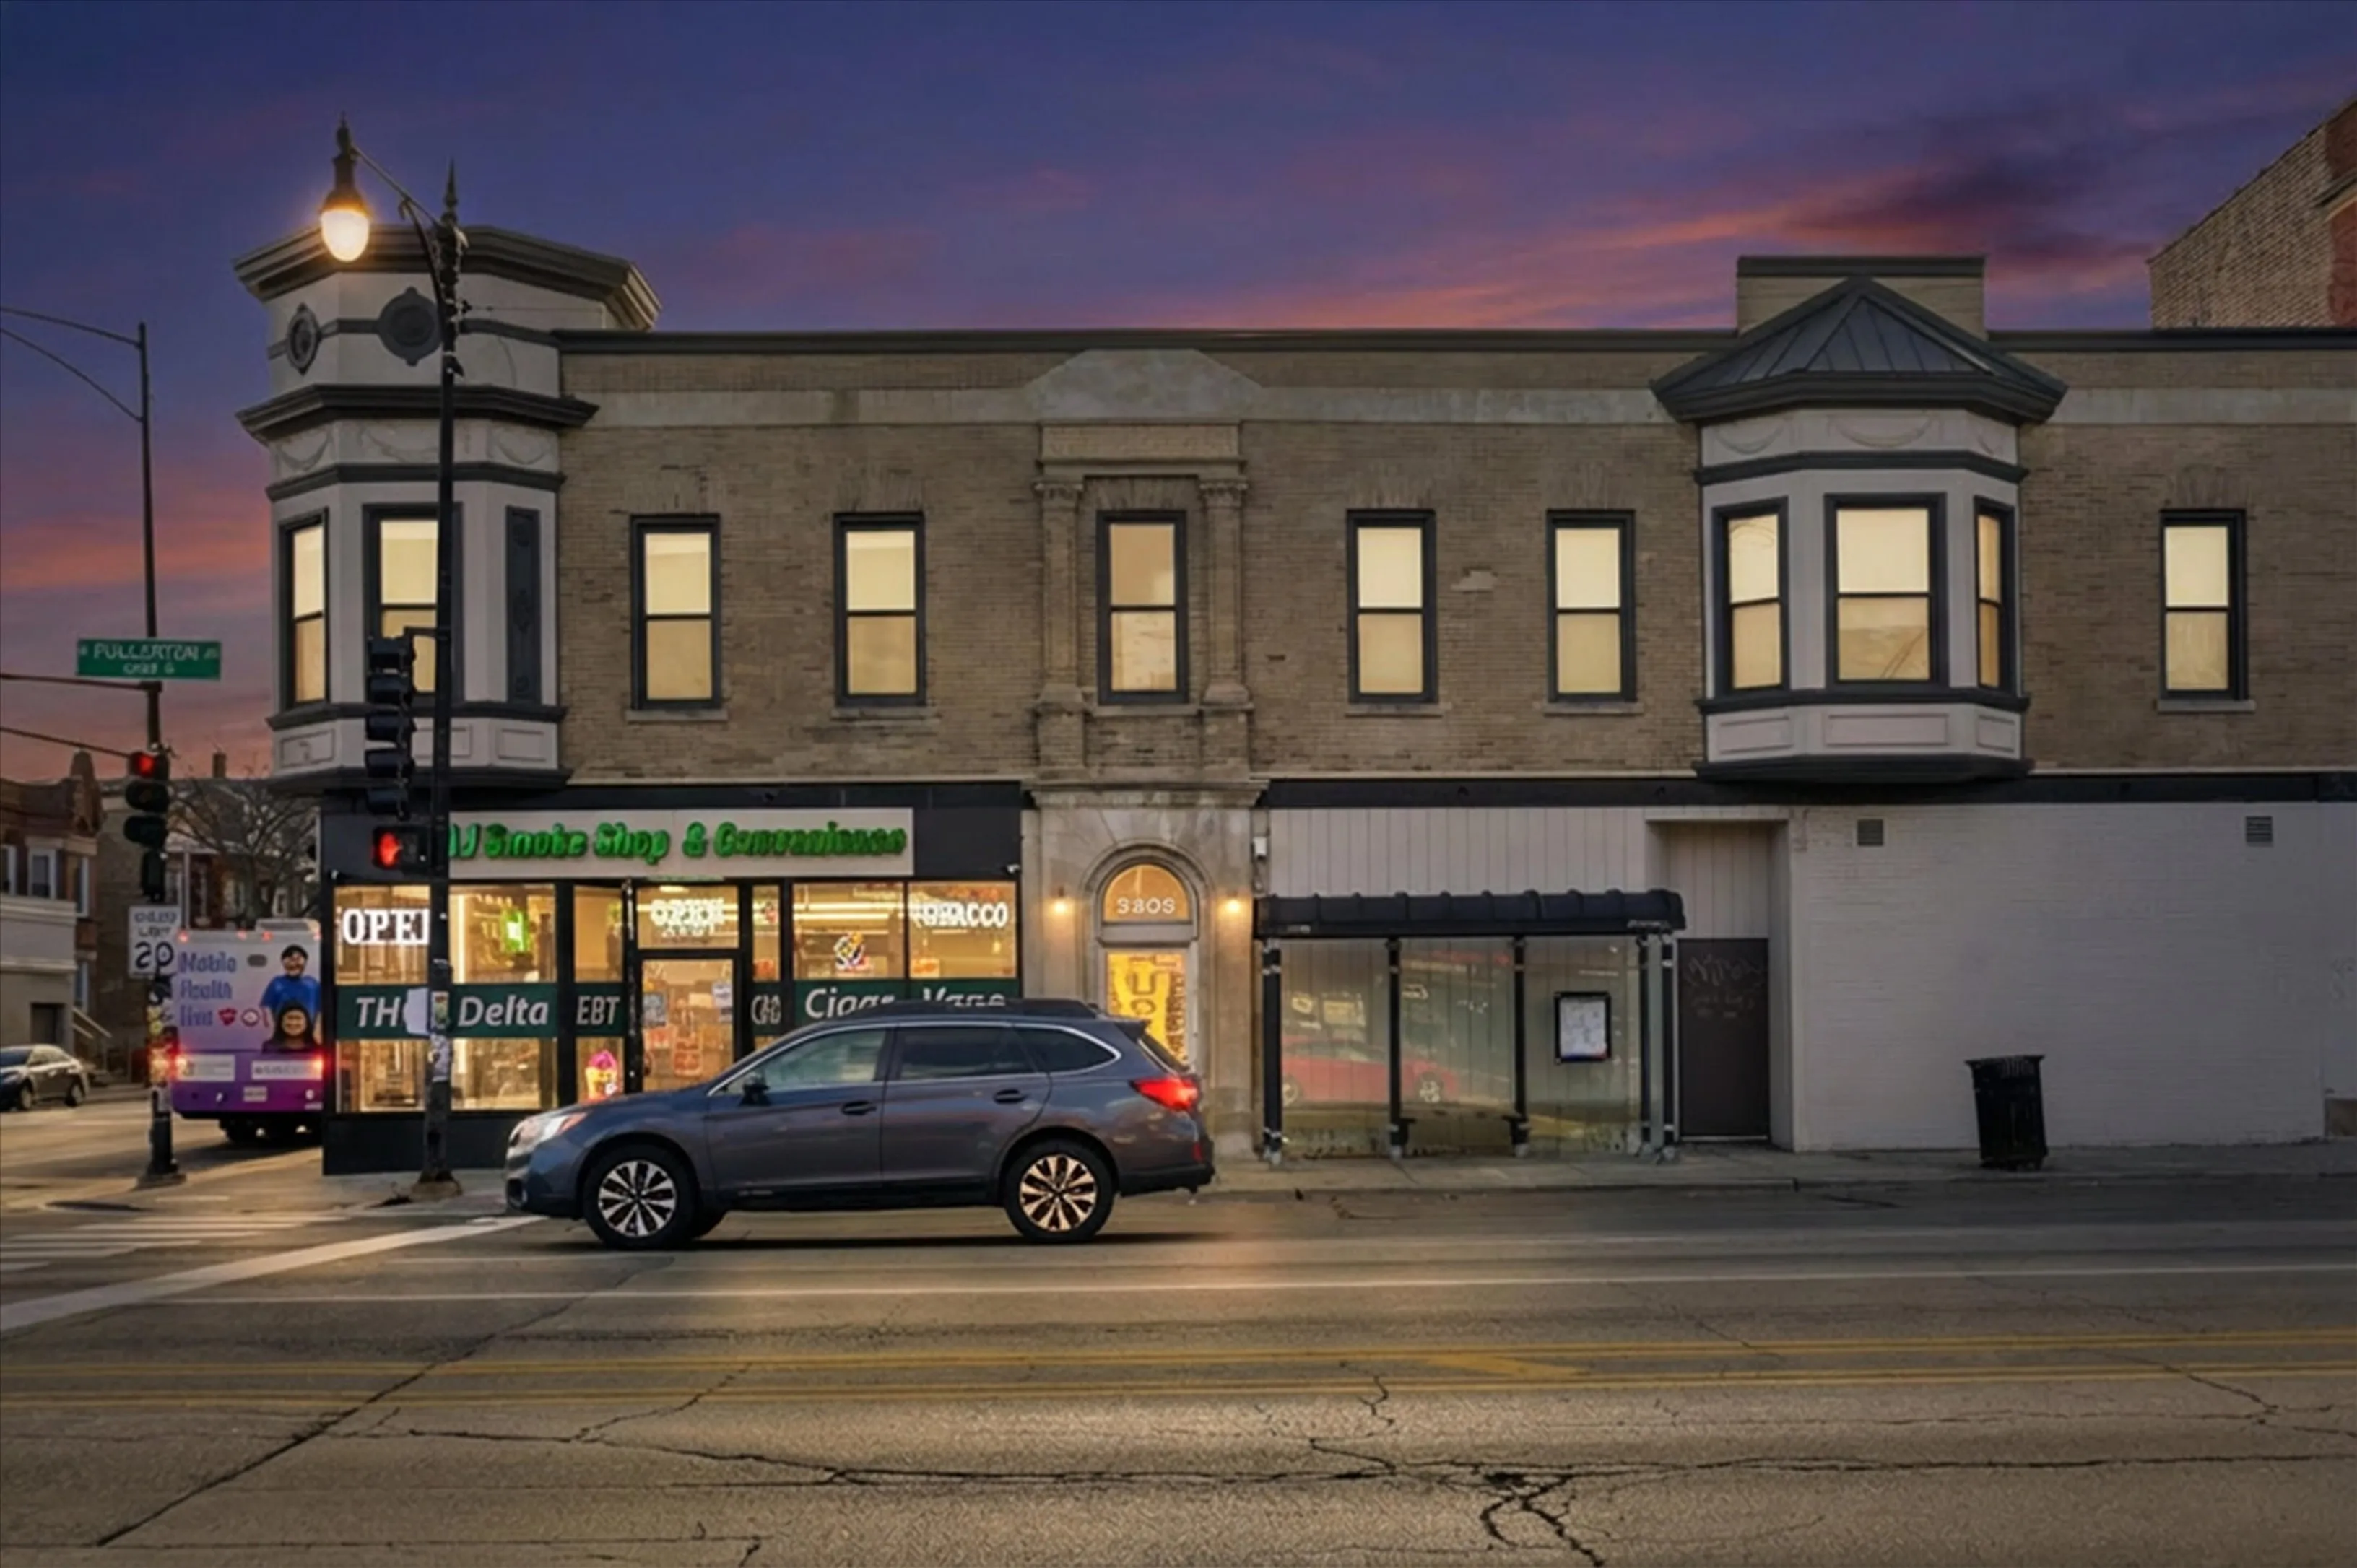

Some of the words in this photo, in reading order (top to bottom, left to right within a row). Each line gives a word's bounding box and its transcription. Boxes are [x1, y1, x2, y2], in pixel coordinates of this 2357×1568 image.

[484, 822, 588, 858] Smoke
[593, 822, 670, 866] Shop
[682, 821, 707, 858] &
[458, 995, 549, 1027] Delta
[576, 996, 620, 1025] EBT
